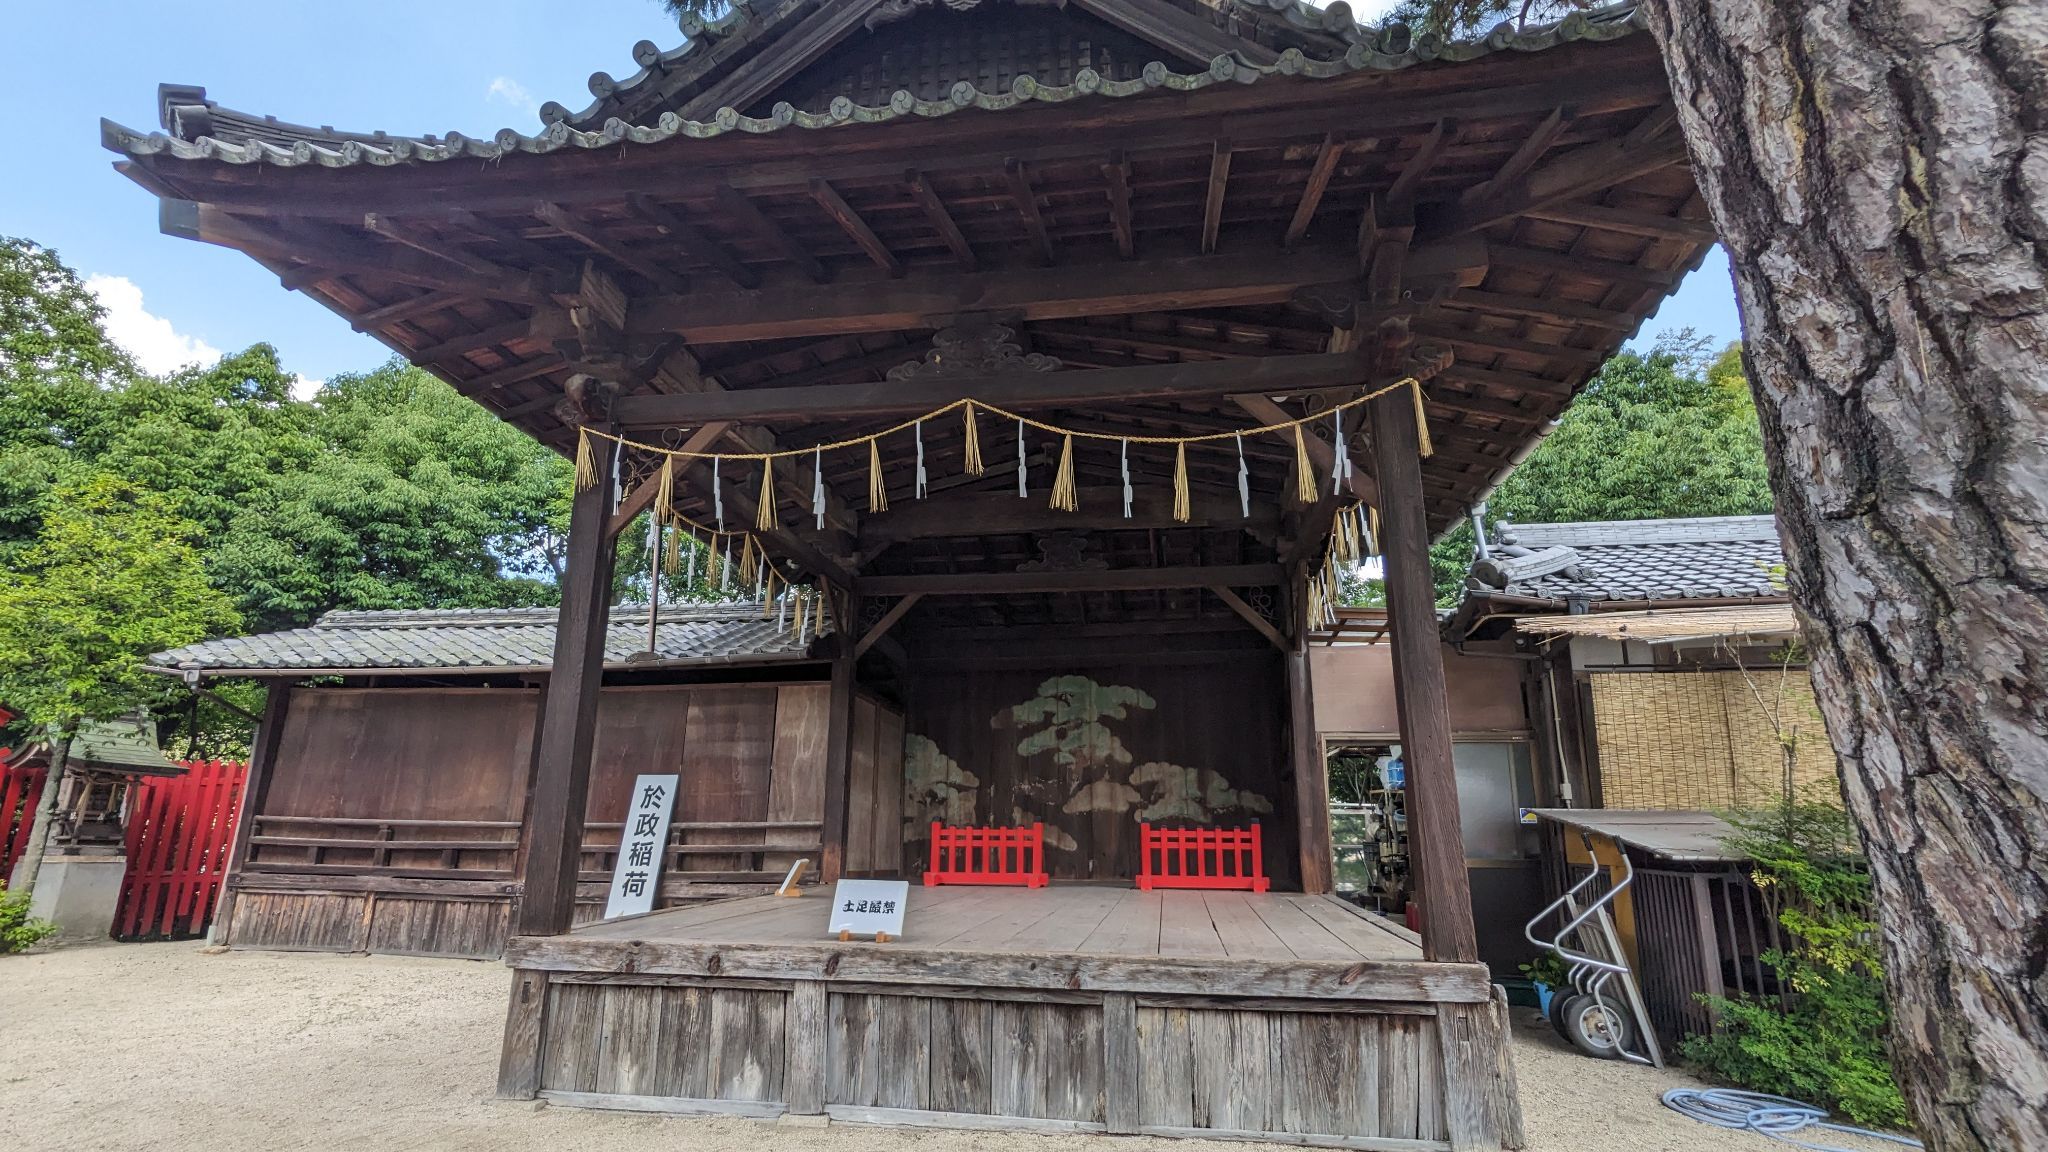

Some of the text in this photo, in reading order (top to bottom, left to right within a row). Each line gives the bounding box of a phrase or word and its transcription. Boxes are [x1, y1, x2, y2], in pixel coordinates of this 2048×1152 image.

[622, 784, 666, 897] 於政稲荷
[842, 899, 896, 914] 土足厳禁
